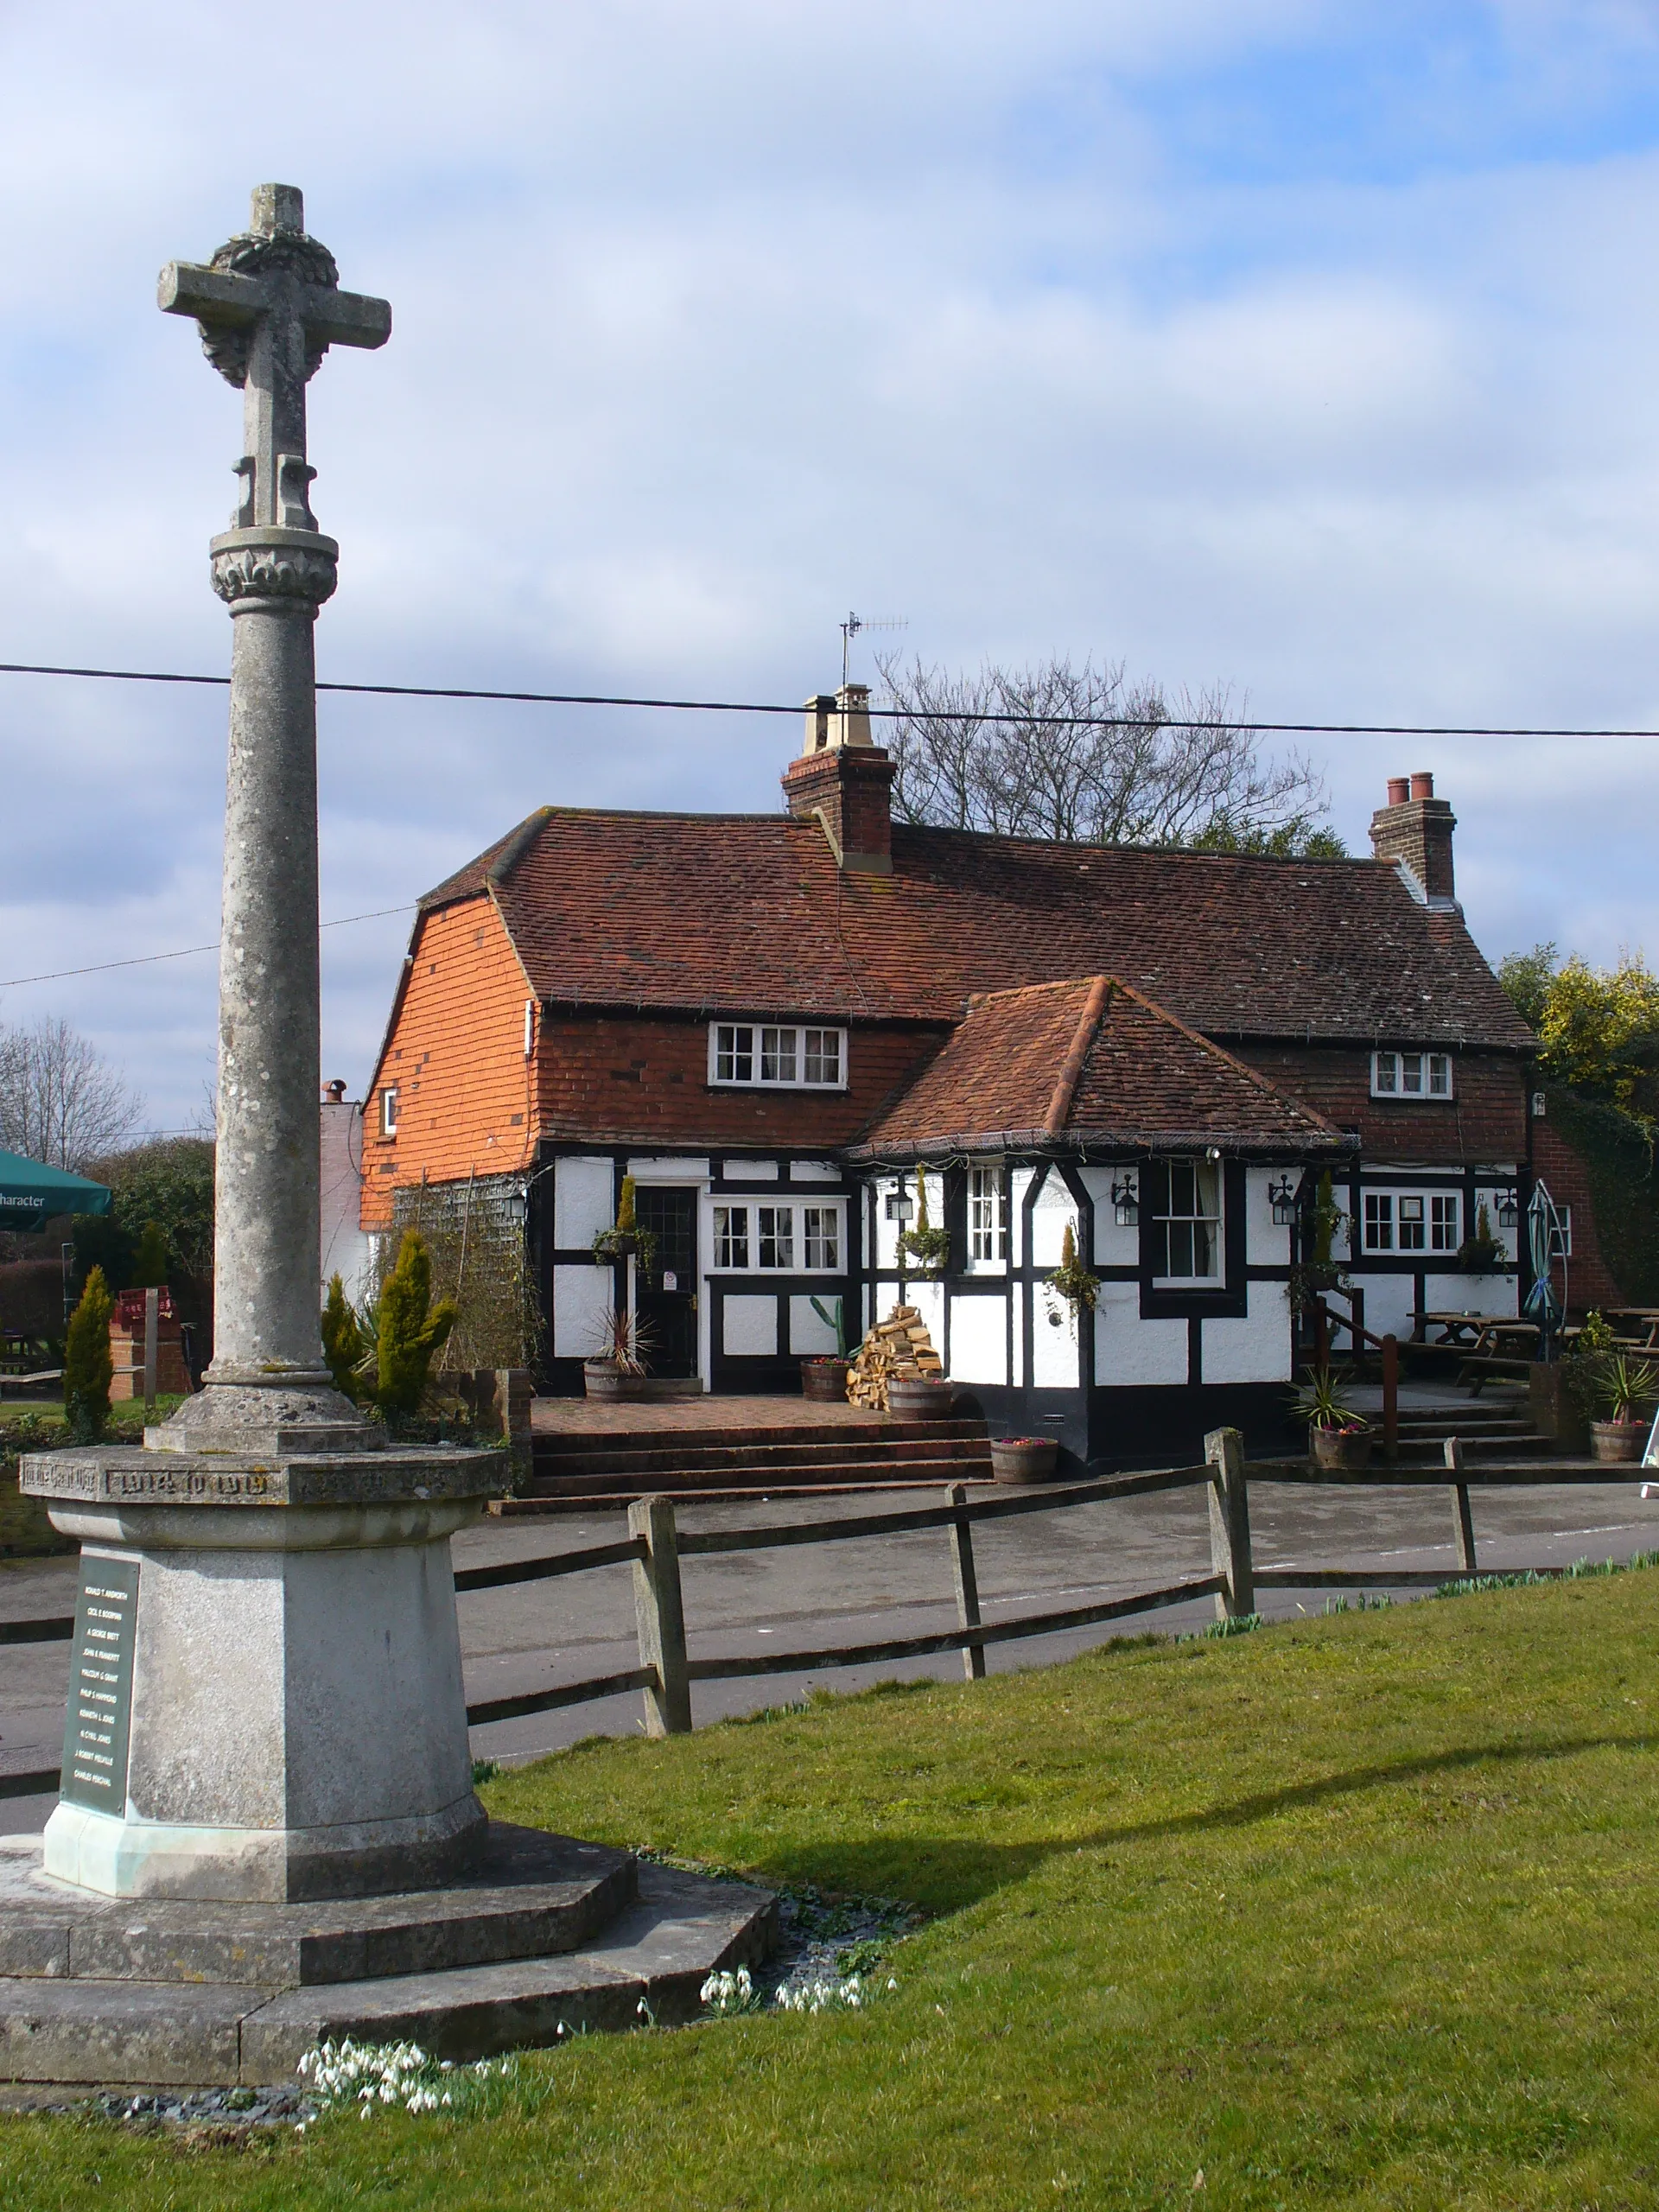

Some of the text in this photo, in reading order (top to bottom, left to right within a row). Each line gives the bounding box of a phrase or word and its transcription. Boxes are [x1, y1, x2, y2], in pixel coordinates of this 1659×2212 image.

[0, 1192, 45, 1206] haracter
[118, 1471, 176, 1494] 1914
[215, 1471, 268, 1495] 1919
